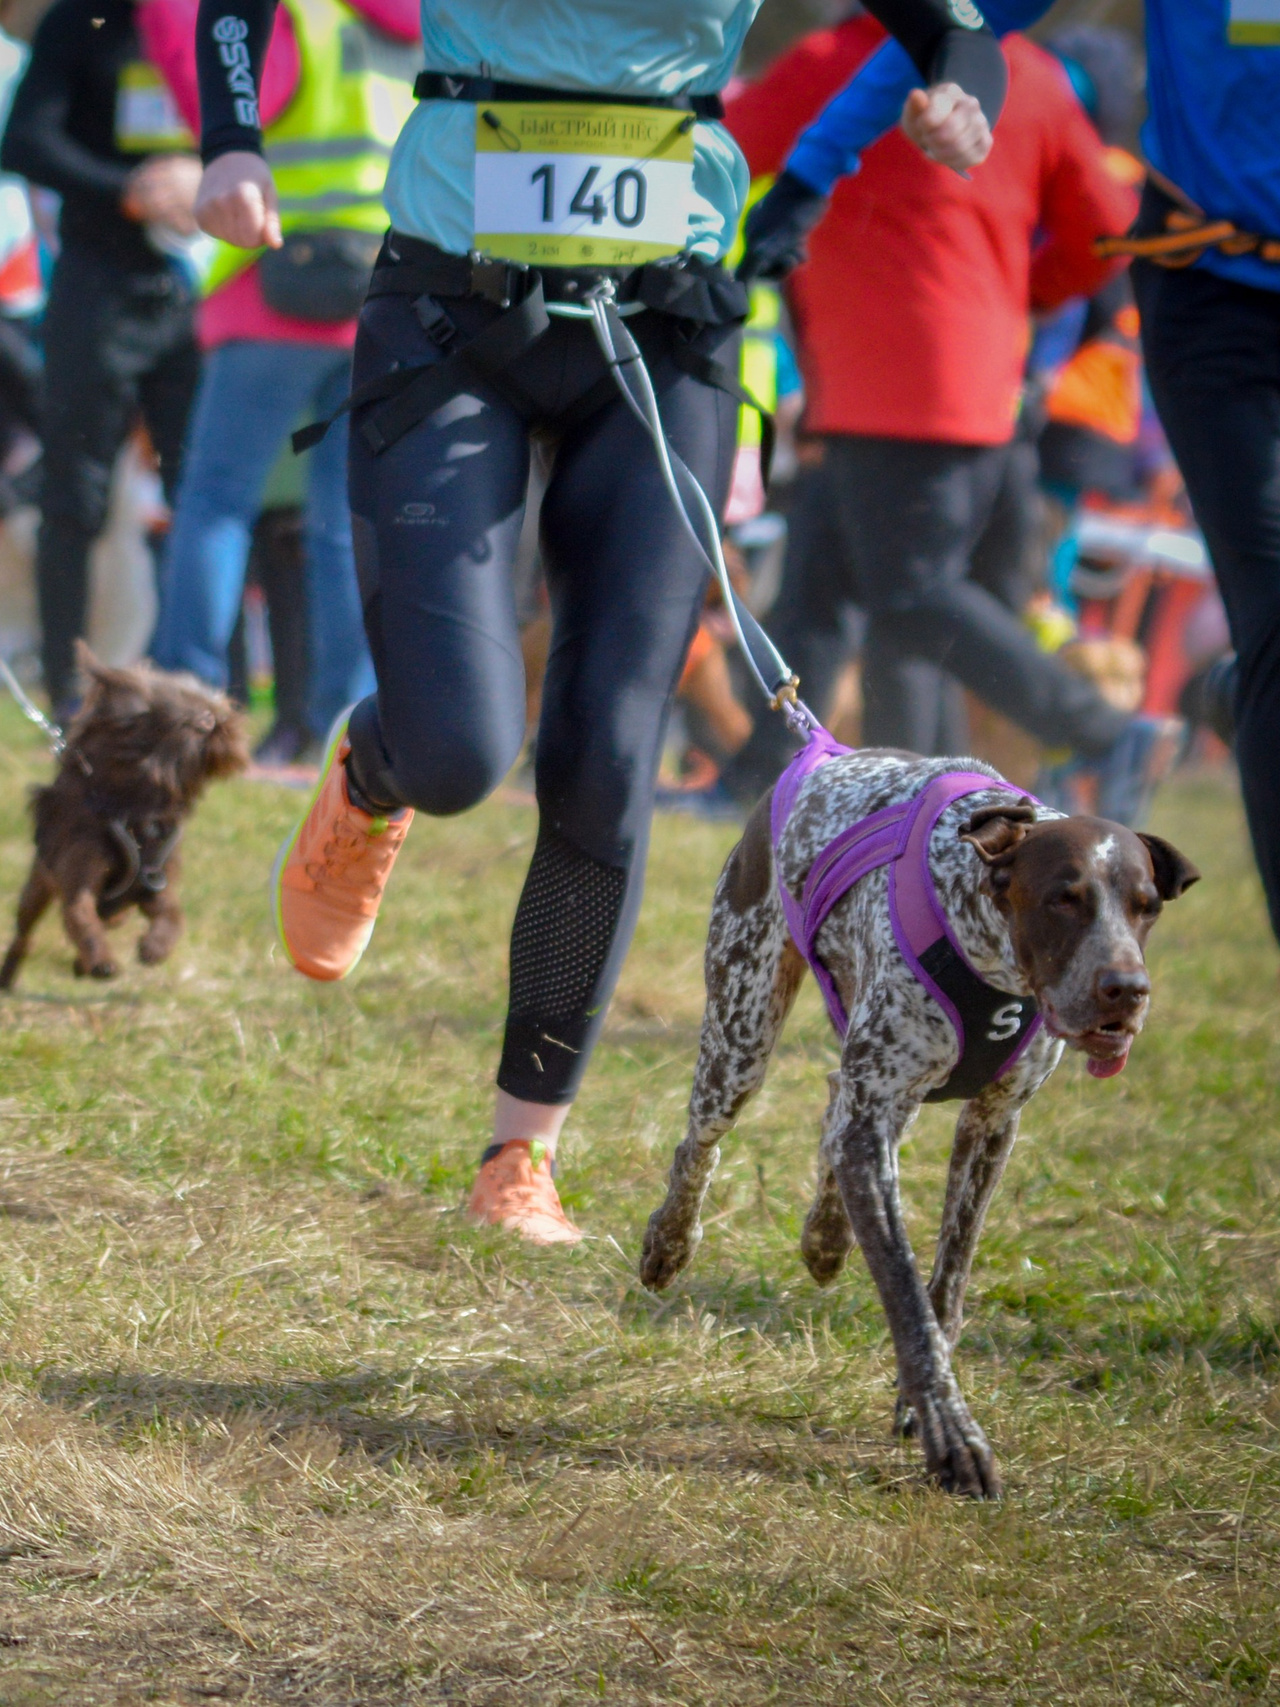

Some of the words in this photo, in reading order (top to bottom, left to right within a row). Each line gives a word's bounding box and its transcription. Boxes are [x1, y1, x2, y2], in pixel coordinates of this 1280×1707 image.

[520, 118, 617, 138] БЫСТРЫЙ
[621, 120, 659, 142] ПЁС
[531, 163, 648, 228] 140
[528, 241, 538, 256] 2
[541, 245, 560, 256] км
[987, 1002, 1023, 1042] S
